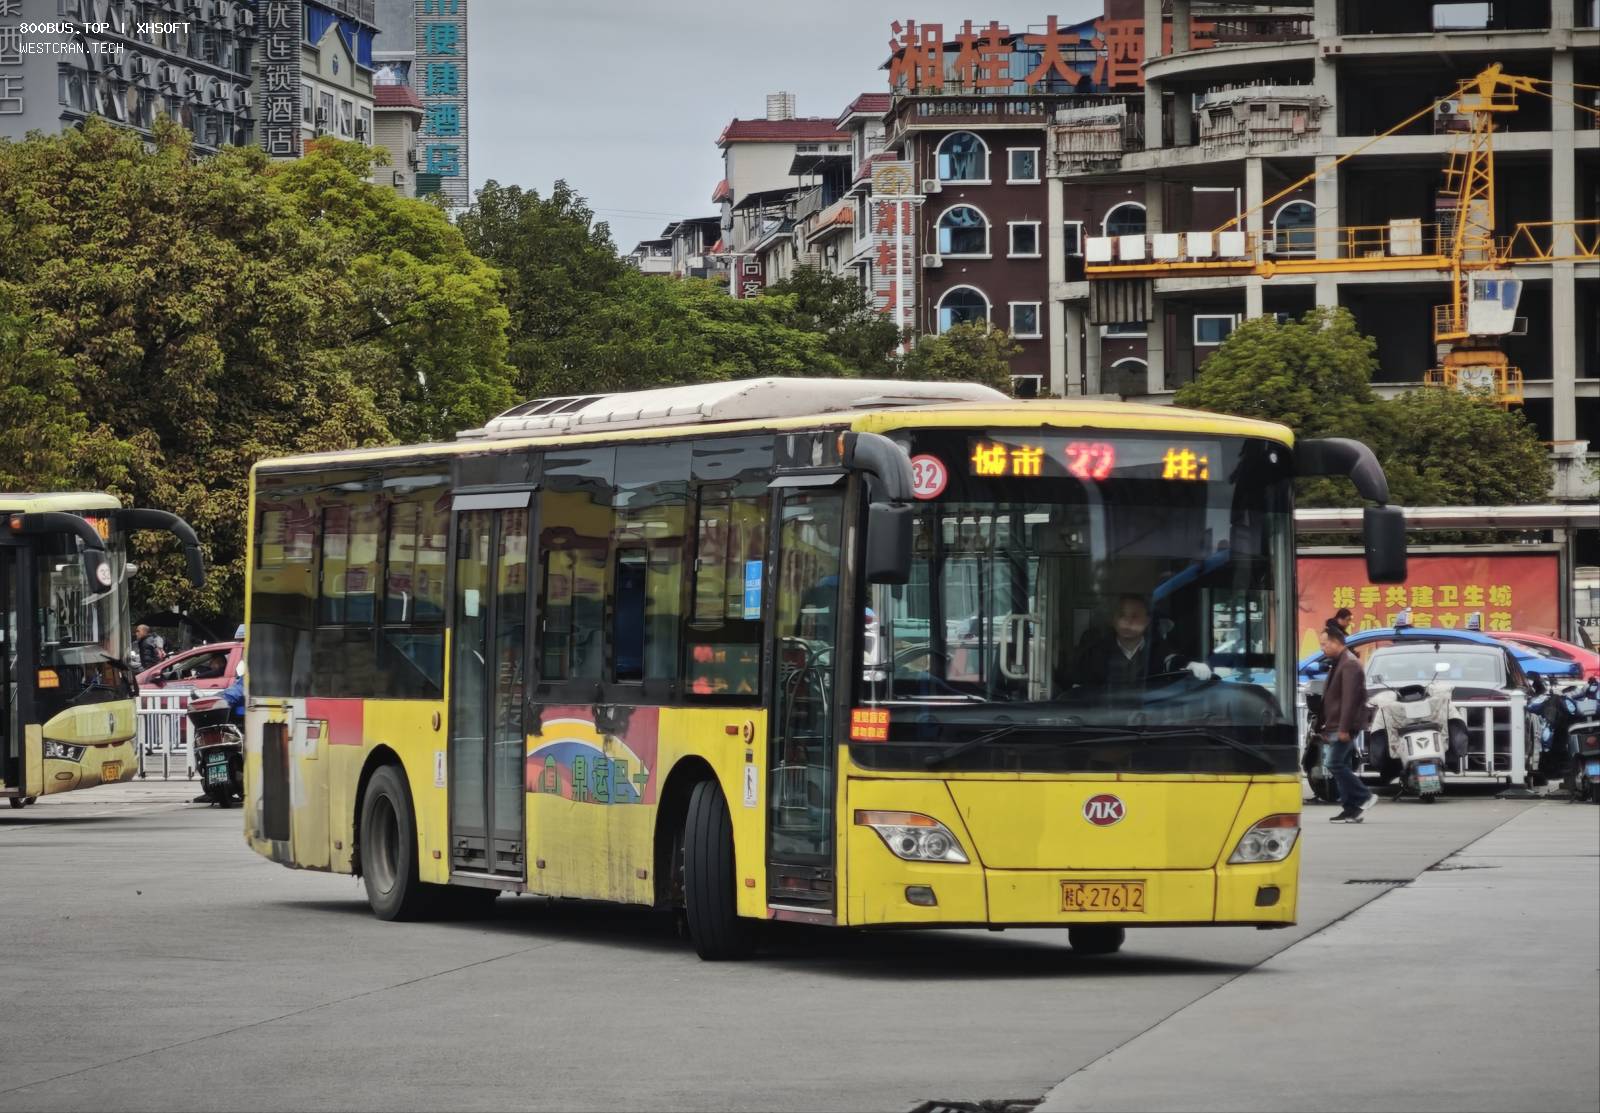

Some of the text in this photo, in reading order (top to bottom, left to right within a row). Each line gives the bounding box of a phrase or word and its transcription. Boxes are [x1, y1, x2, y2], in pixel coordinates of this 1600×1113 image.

[266, 1, 292, 154] 优连锁酒店
[875, 200, 913, 354] 湘桂大
[911, 463, 937, 489] 32
